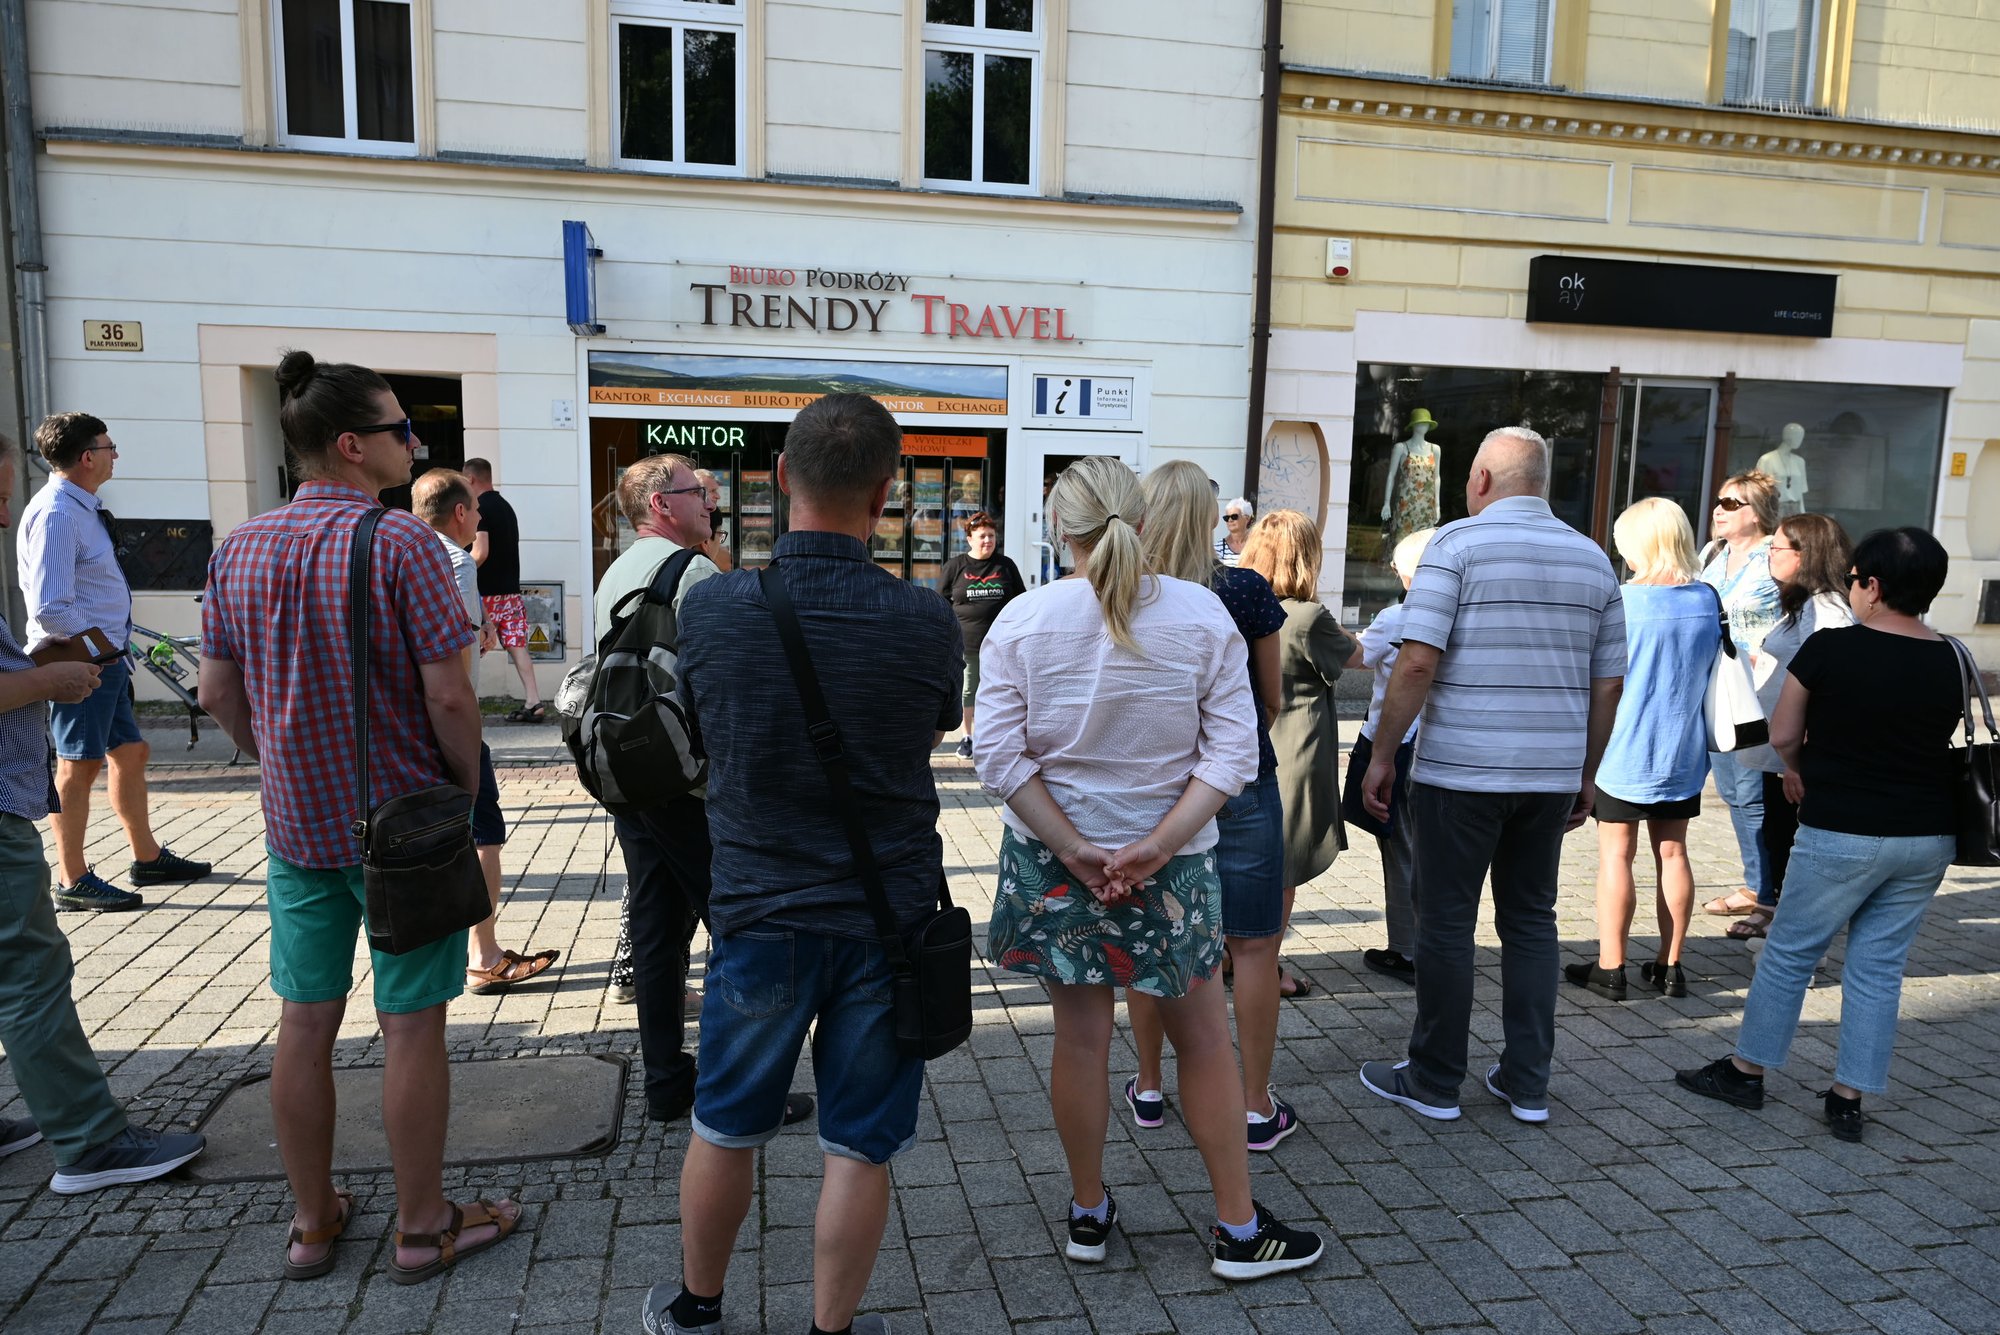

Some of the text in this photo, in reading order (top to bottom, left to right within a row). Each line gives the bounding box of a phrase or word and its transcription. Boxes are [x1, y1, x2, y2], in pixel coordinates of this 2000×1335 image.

[729, 265, 911, 291] BIURO PODRÓŻY
[690, 283, 1074, 341] TRENDY TRAVEL
[101, 324, 124, 340] 36
[595, 390, 651, 402] KANTOR
[658, 392, 732, 405] EXCHANGE
[744, 395, 790, 407] BIURO
[882, 401, 925, 411] ANTOR
[937, 401, 1005, 413] EXCHANGE
[647, 424, 745, 447] KANTOR
[914, 436, 973, 446] WYCIECZKI
[903, 445, 947, 453] DNIOWE
